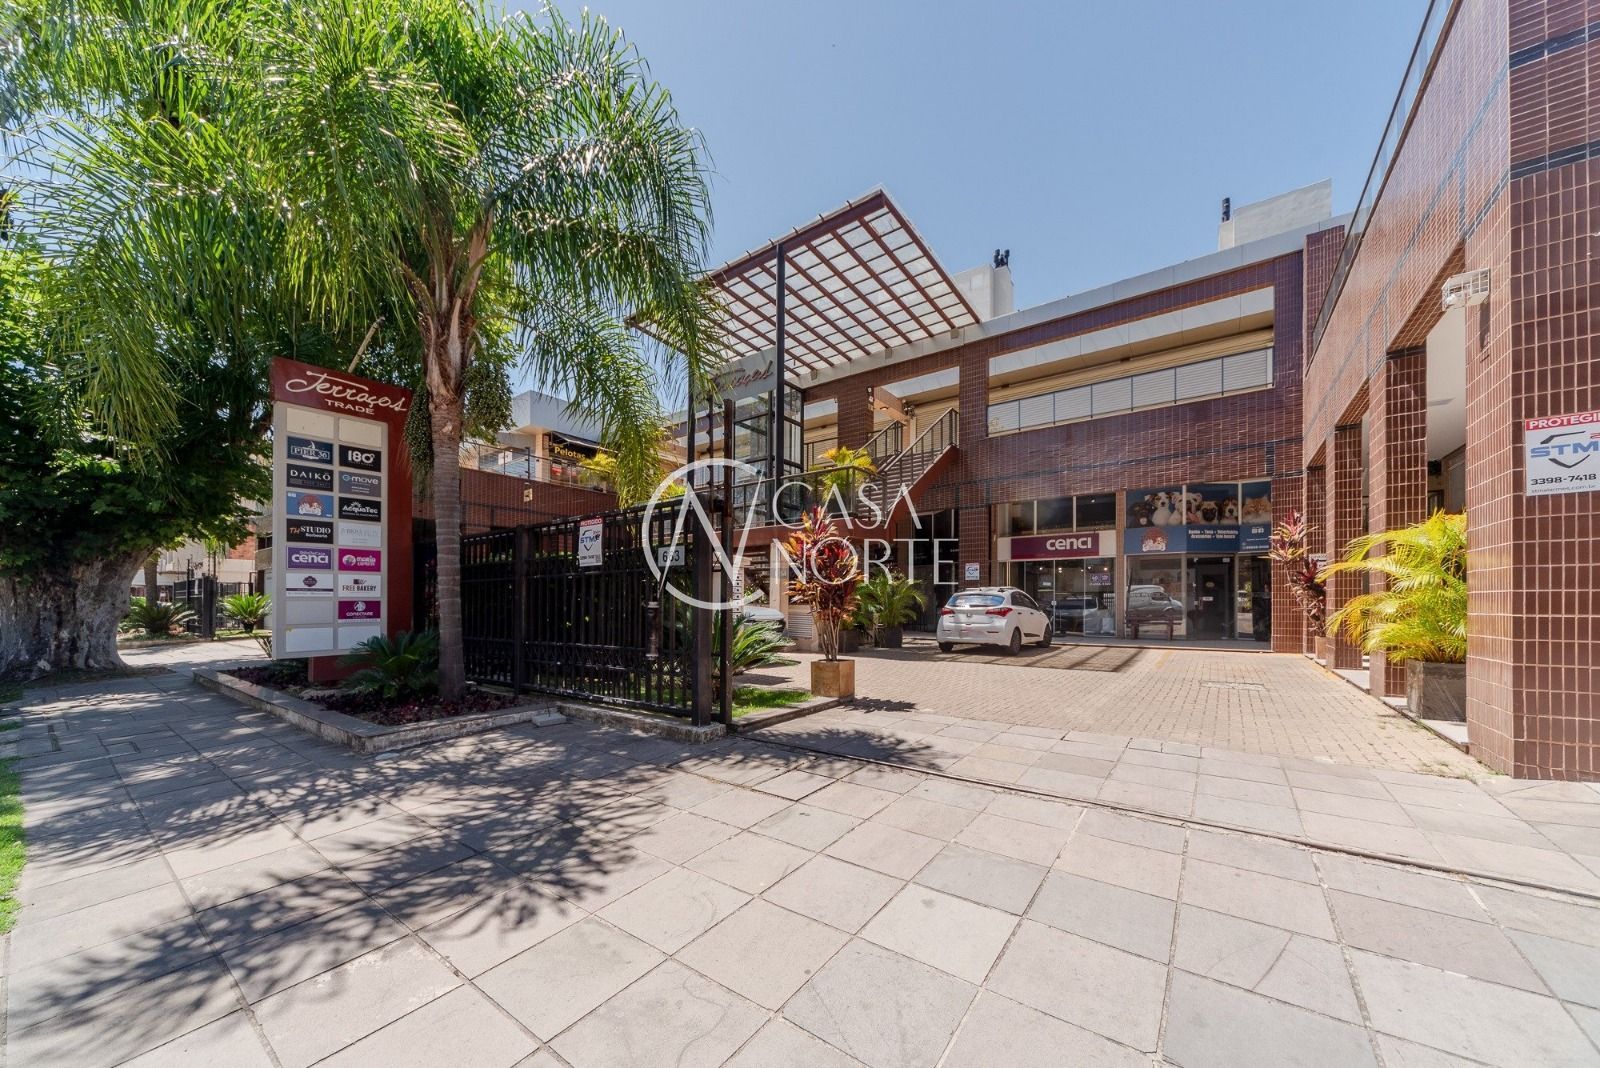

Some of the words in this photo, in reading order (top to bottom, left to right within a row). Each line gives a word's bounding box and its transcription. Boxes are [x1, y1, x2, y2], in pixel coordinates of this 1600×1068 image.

[285, 370, 407, 411] Terraços
[324, 398, 375, 415] TRADE
[1529, 412, 1600, 430] PROTEGI
[294, 447, 316, 457] PIER
[554, 446, 586, 460] Pelotas
[1530, 473, 1597, 486] 3398-7418
[300, 525, 331, 534] STUDIO
[1046, 537, 1092, 551] cenci
[291, 553, 329, 564] cenci
